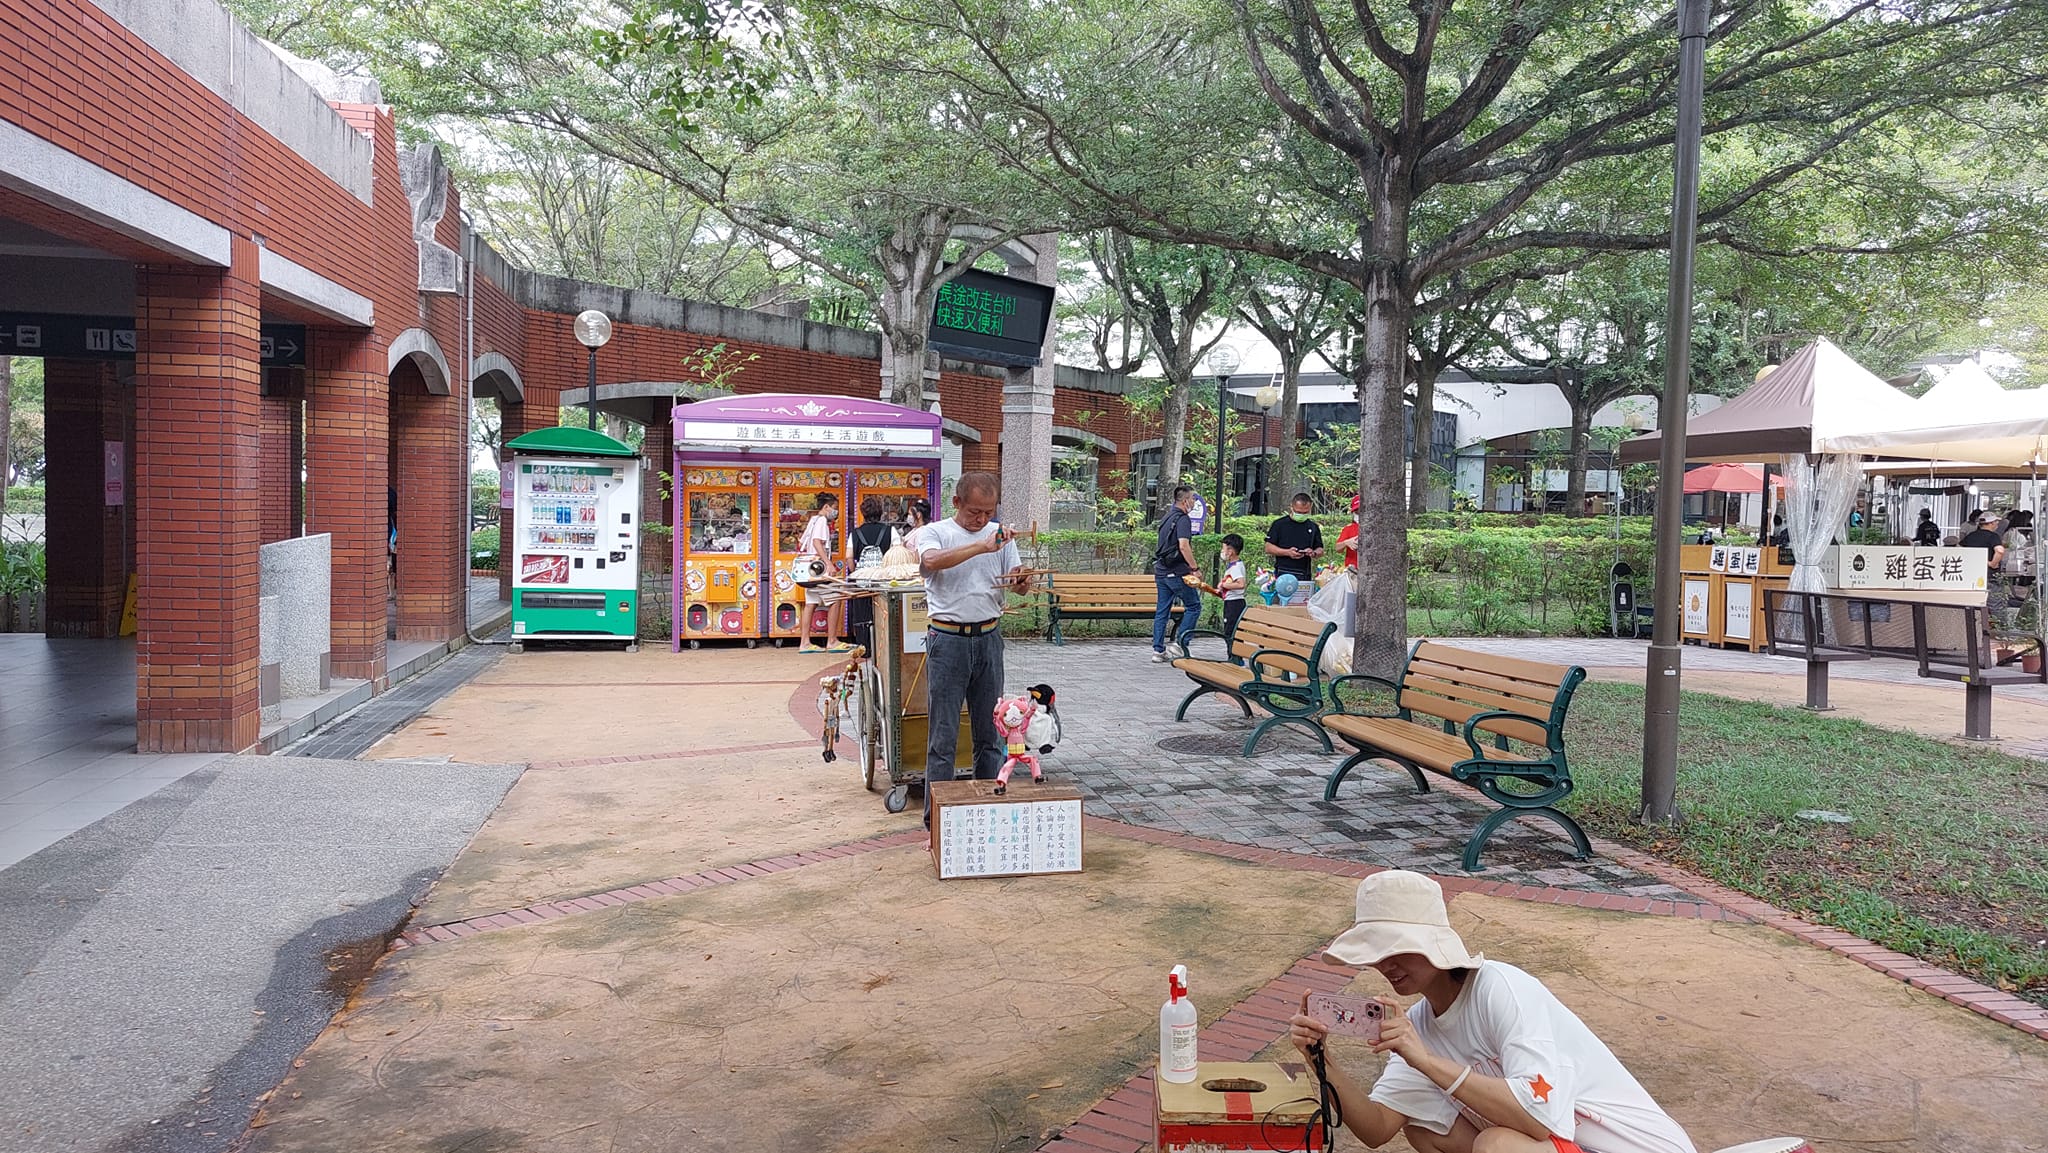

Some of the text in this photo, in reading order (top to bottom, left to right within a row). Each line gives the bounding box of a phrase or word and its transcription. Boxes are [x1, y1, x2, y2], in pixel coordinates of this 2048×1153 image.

[938, 281, 1017, 316] 長途改走台61
[936, 304, 1004, 337] 快速又便利
[1713, 549, 1757, 571] 雞蛋糕
[1884, 553, 1964, 582] 雞蛋糕
[1035, 805, 1044, 842] 大家看了
[1046, 805, 1055, 869] 不論男女和老幼
